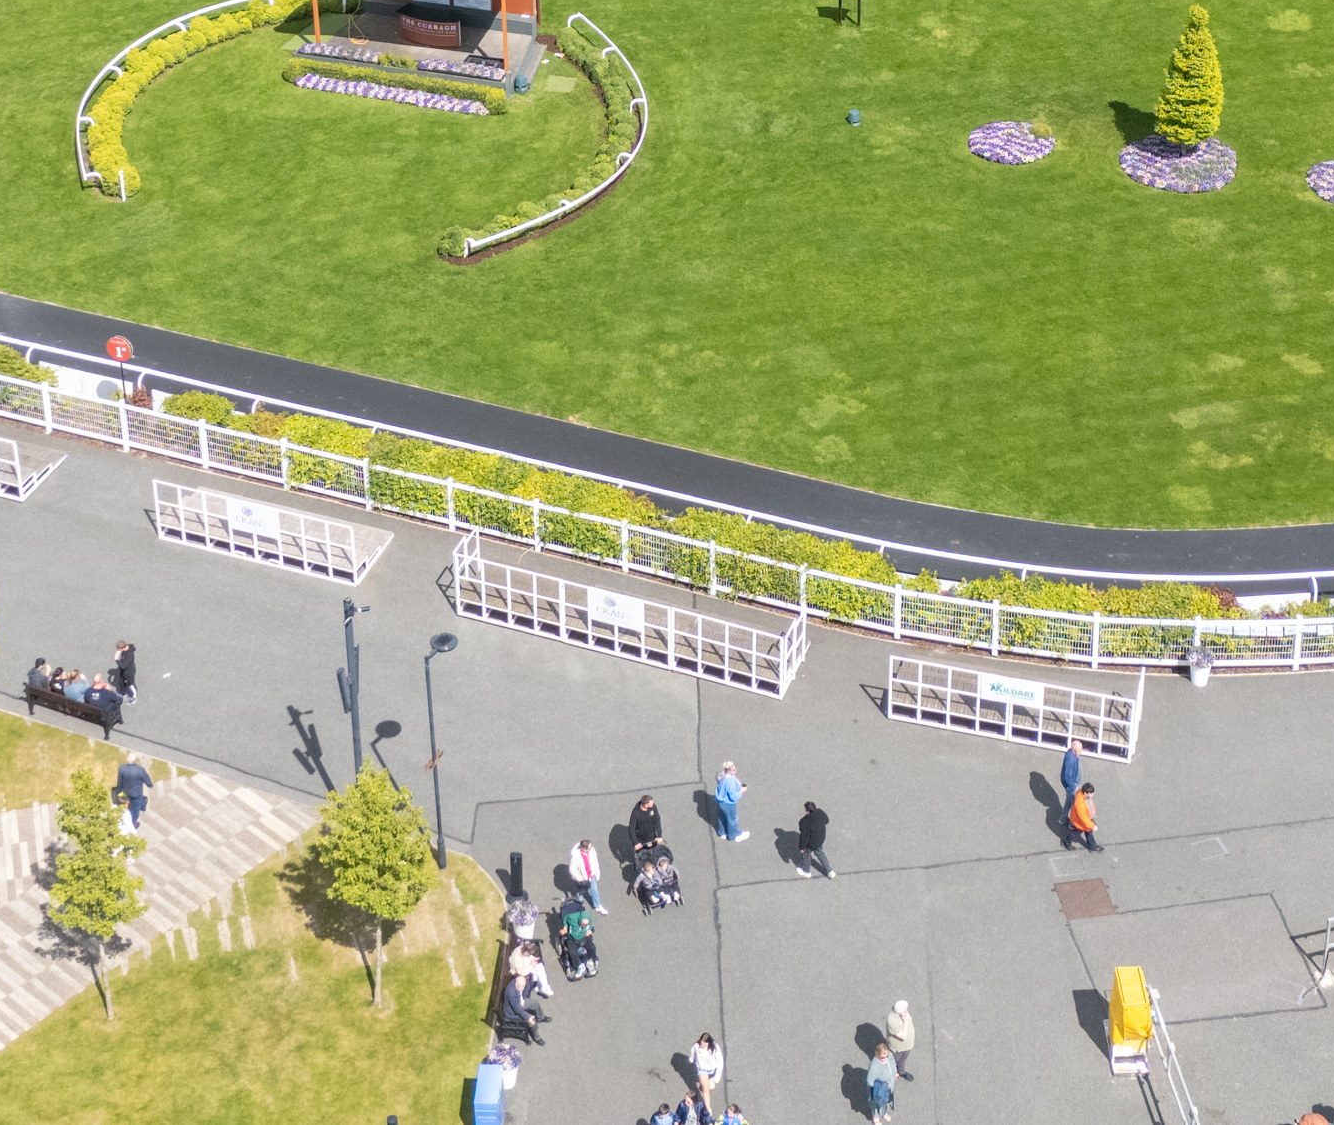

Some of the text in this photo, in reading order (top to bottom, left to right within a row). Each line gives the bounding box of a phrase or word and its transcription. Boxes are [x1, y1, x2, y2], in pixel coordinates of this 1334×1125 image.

[402, 16, 457, 31] THE CURRAGH
[995, 681, 1035, 698] KILDARE
